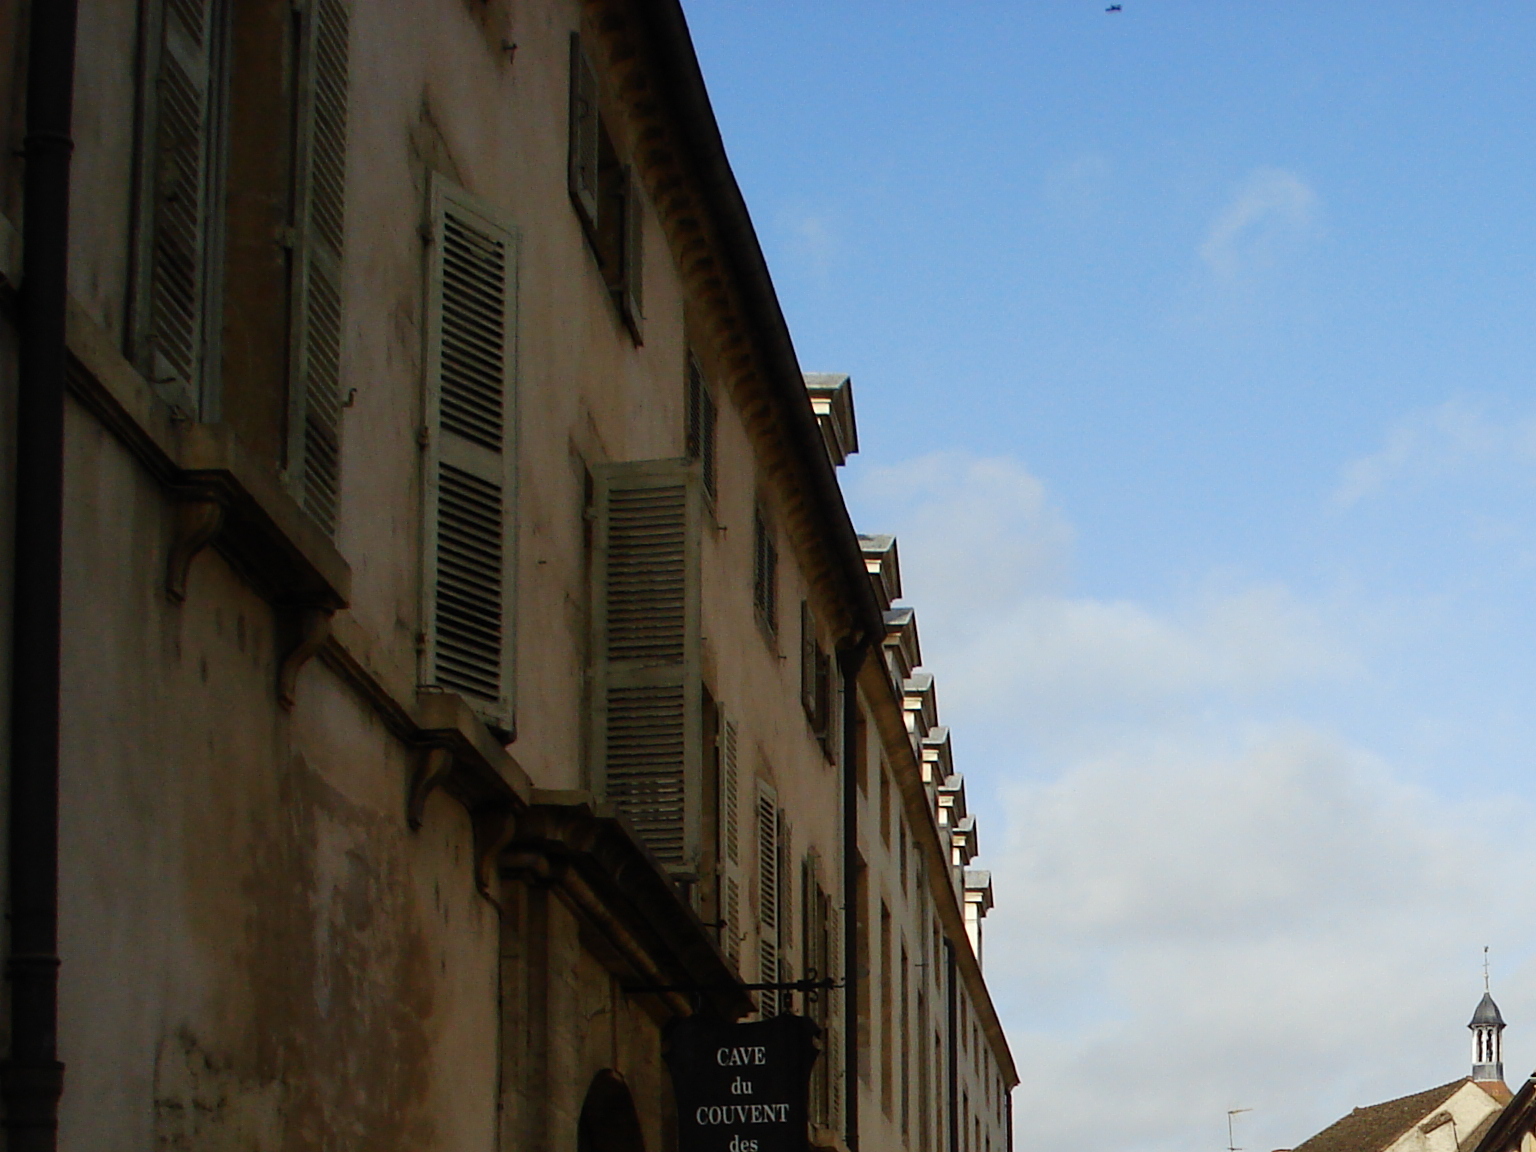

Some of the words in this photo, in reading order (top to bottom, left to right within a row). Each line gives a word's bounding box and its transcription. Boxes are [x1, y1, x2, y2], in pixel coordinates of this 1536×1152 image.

[716, 1046, 766, 1067] CAVE
[730, 1076, 753, 1096] du
[696, 1103, 790, 1126] COUVENT
